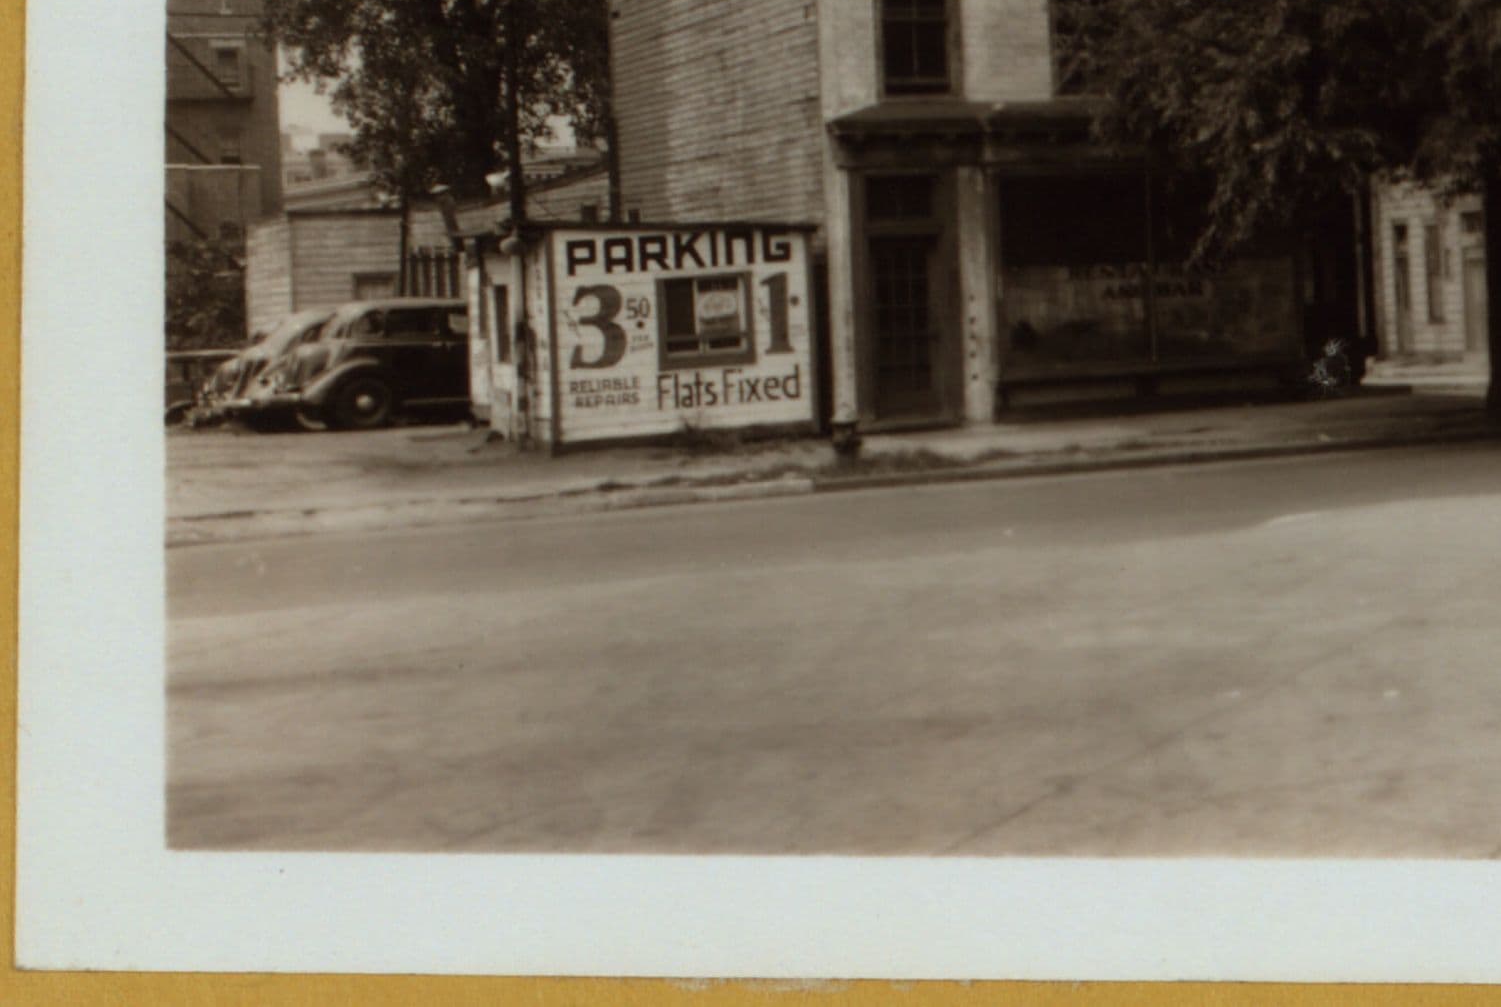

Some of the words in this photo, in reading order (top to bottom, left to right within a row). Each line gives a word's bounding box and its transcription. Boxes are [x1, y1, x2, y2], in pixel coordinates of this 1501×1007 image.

[569, 376, 641, 394] RELIABLE
[656, 370, 719, 411] Flats
[722, 363, 802, 403] Fixed
[575, 392, 640, 409] REPAIRS
